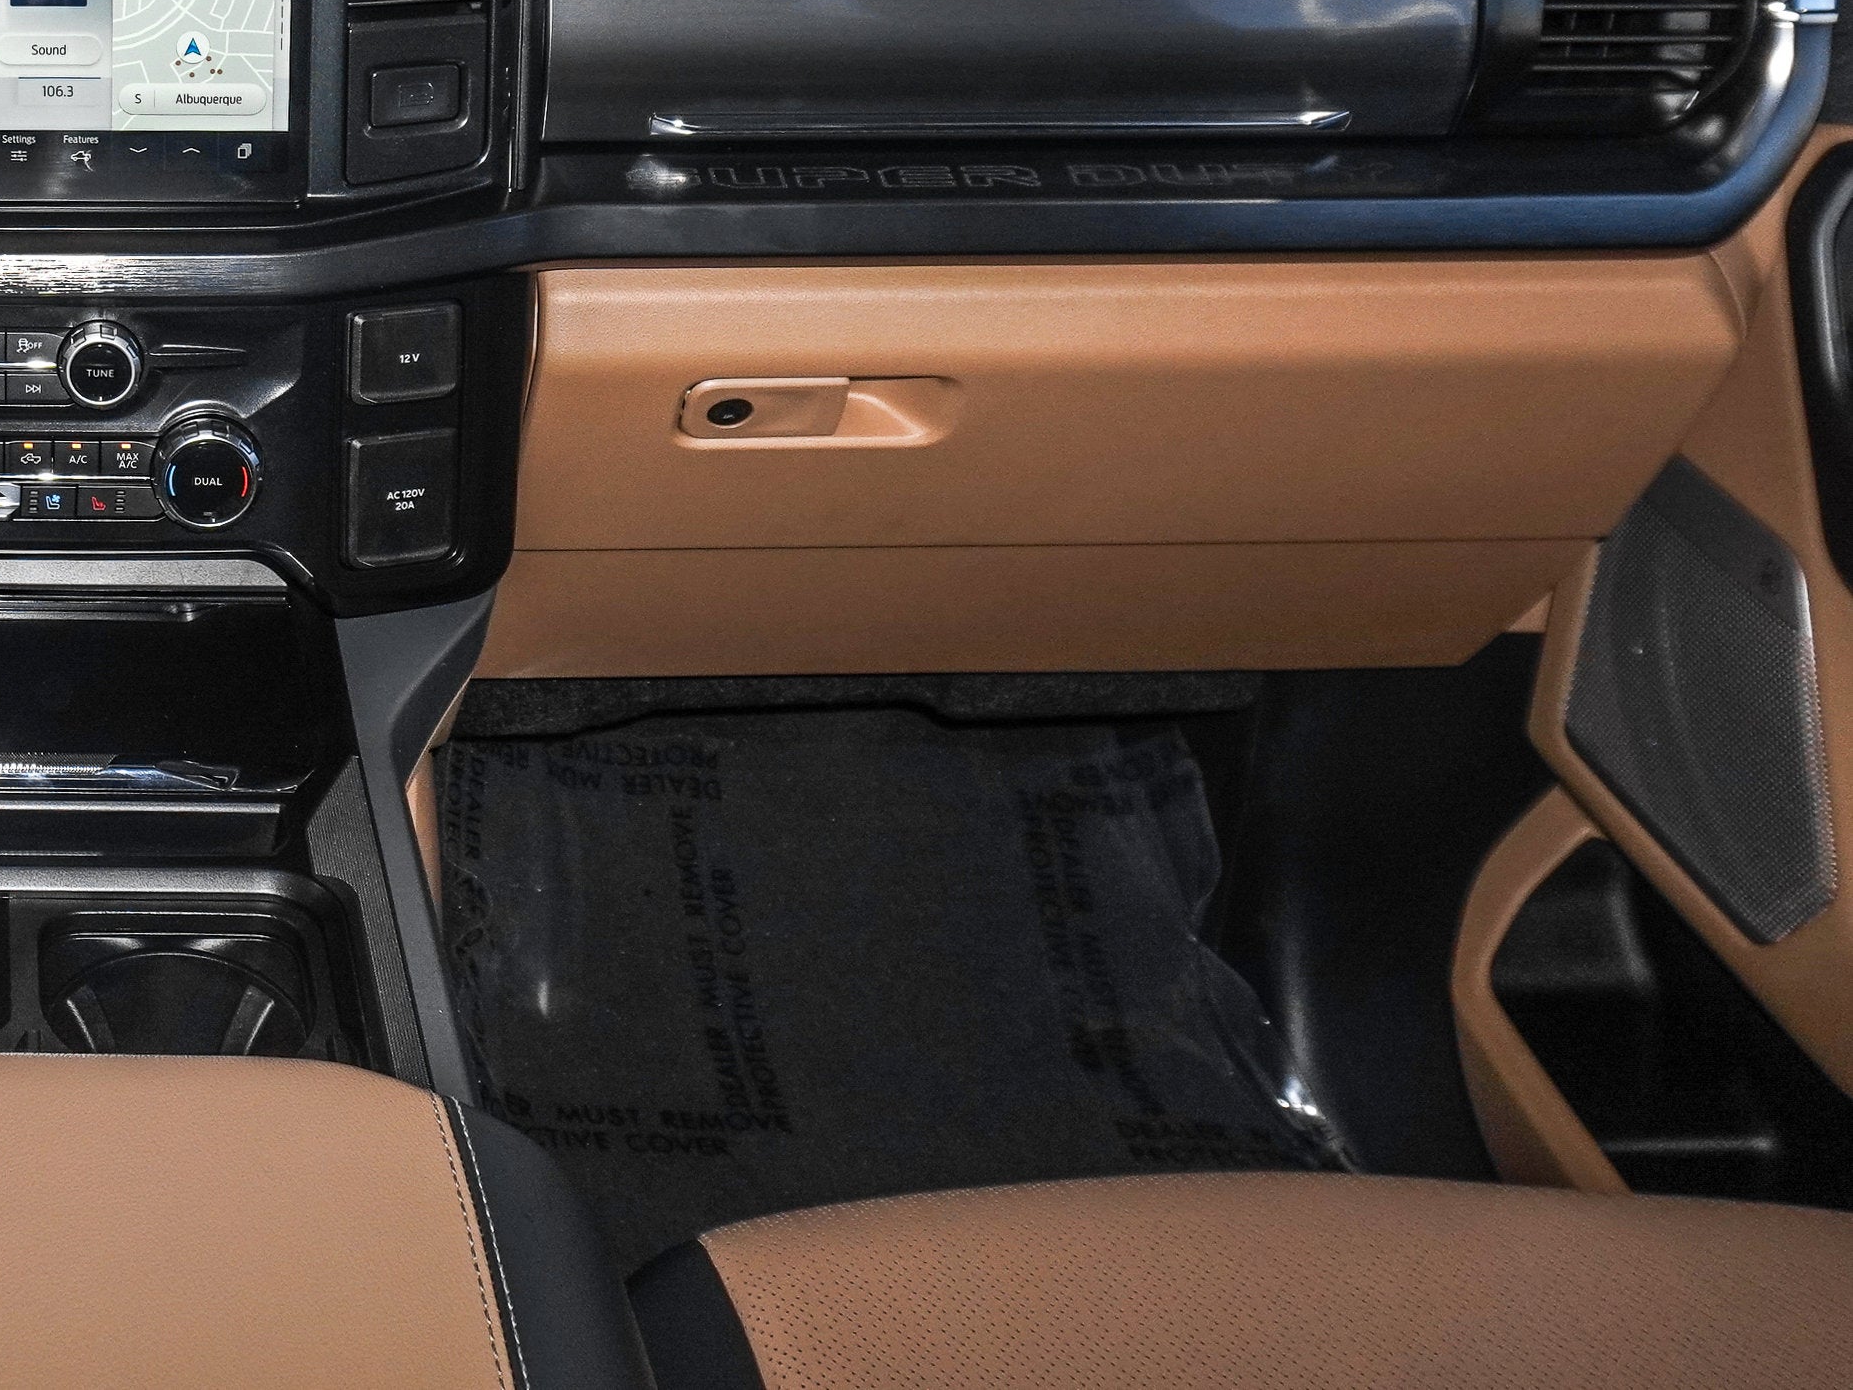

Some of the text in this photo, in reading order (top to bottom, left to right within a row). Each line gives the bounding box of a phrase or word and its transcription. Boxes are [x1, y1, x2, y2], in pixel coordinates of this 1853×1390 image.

[31, 44, 67, 56] Sound
[42, 85, 74, 97] 106.3
[134, 93, 142, 105] S
[175, 93, 243, 107] Albuquerque
[2, 134, 36, 145] Settings
[63, 134, 99, 144] Features
[625, 164, 1043, 191] SUPER
[27, 341, 43, 350] OFF
[86, 368, 115, 378] TUNE
[69, 453, 88, 465] A/C
[116, 452, 140, 462] MAX
[118, 459, 138, 470] A/C
[194, 476, 223, 486] DUAL
[386, 488, 426, 500] AC 120V
[395, 501, 415, 511] 20A
